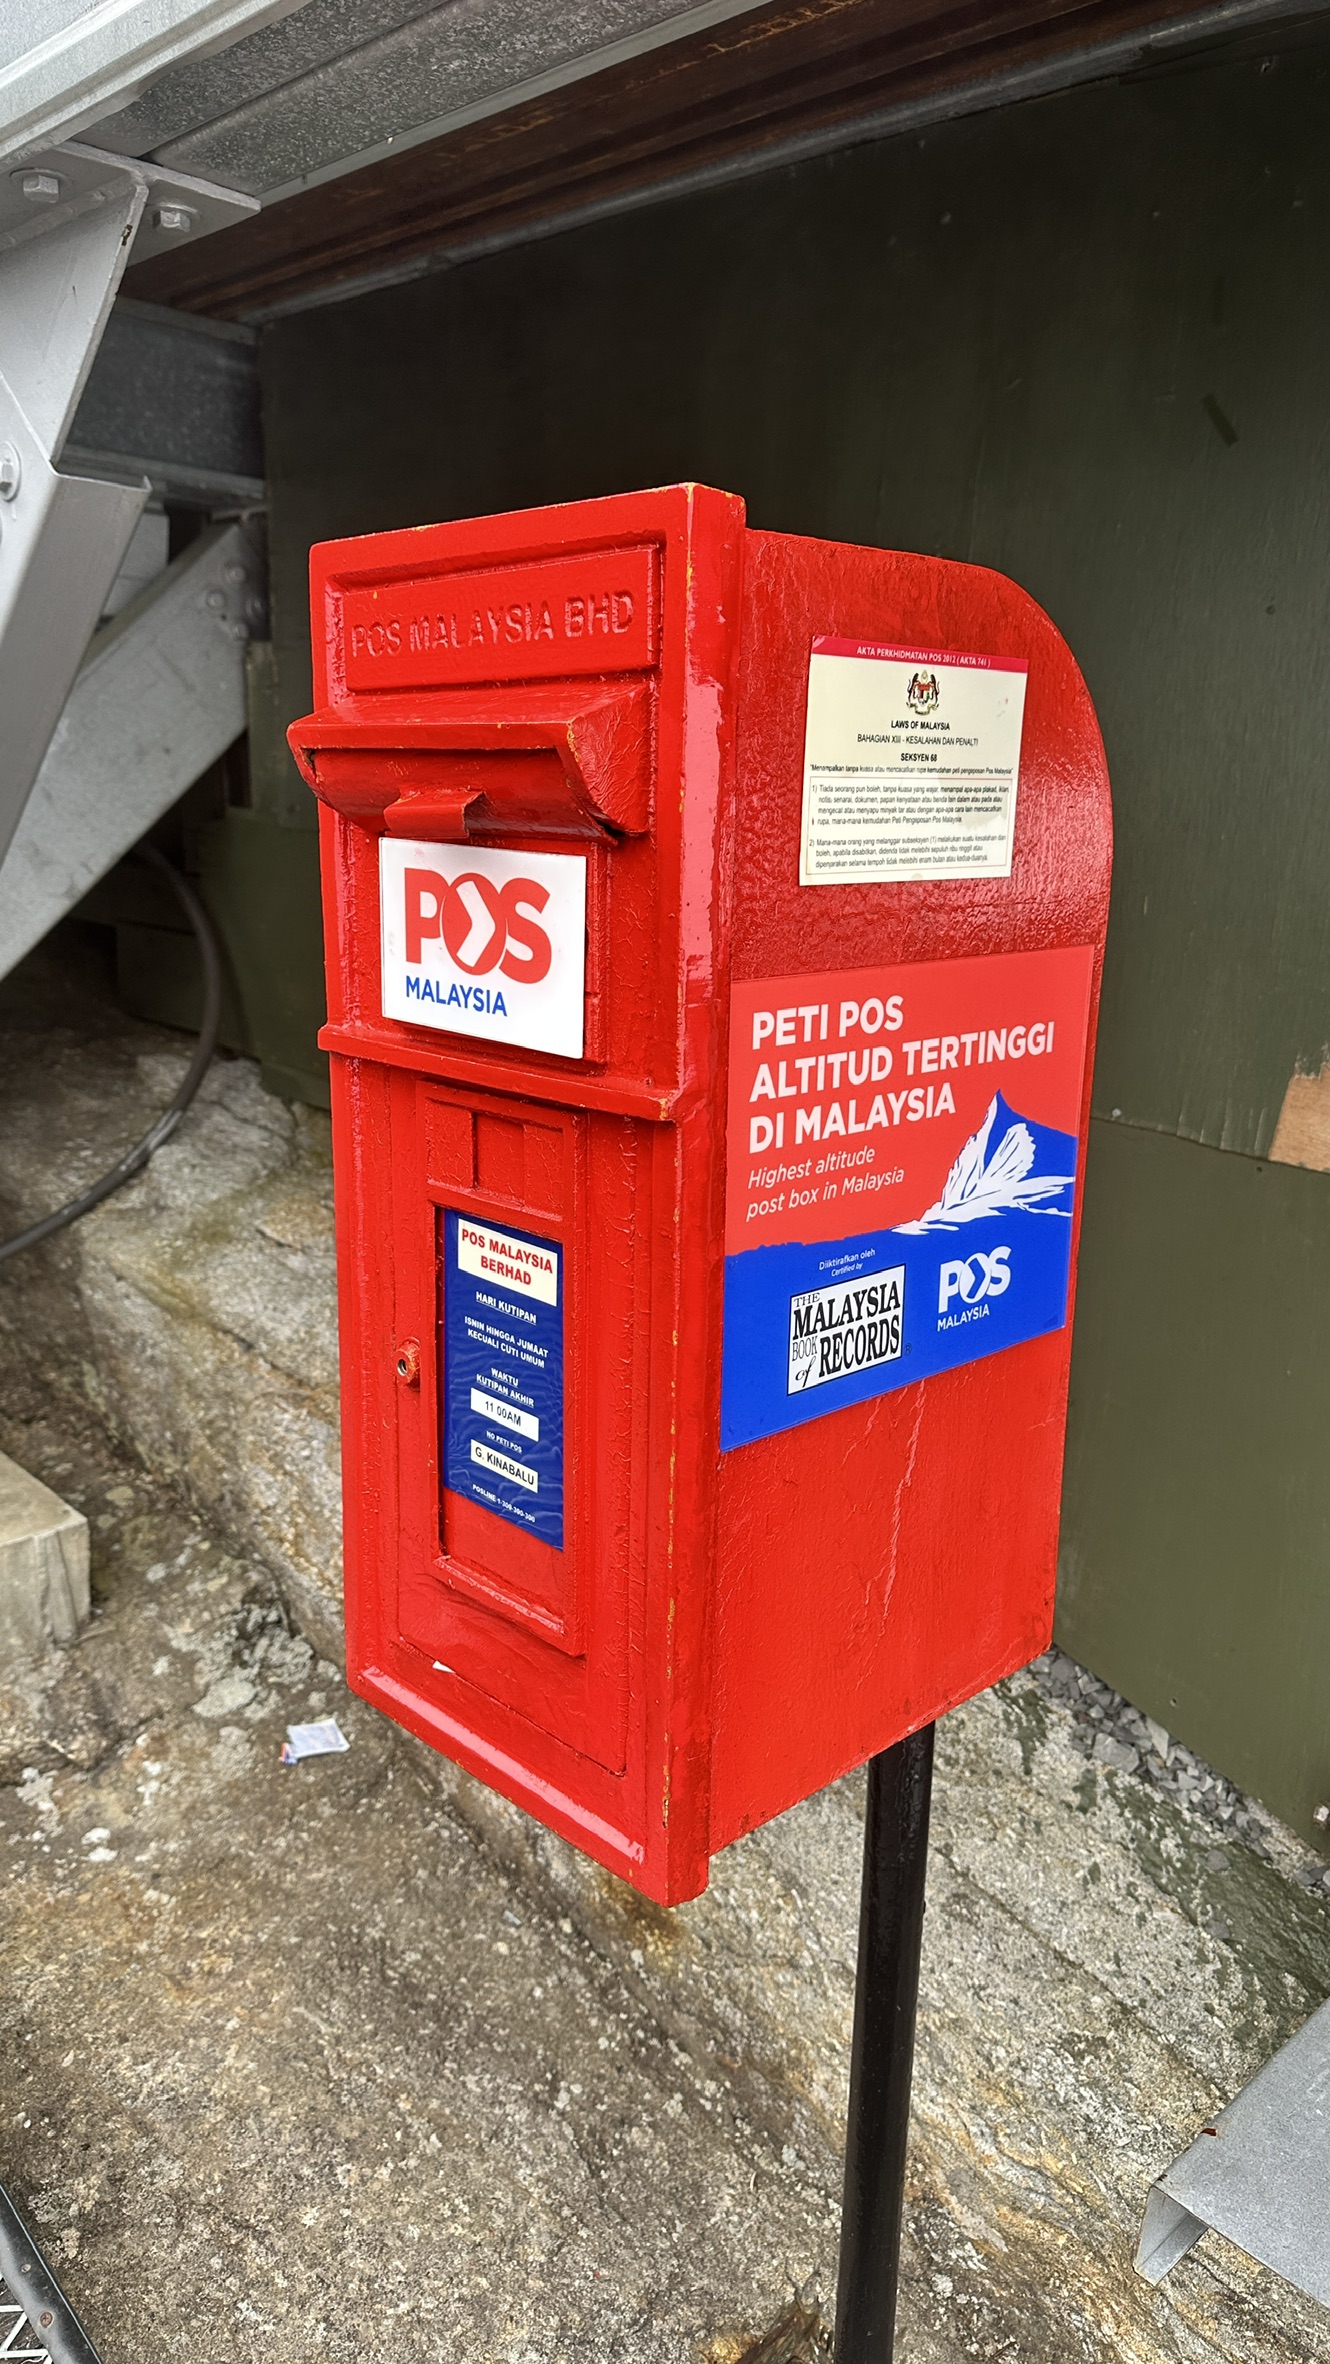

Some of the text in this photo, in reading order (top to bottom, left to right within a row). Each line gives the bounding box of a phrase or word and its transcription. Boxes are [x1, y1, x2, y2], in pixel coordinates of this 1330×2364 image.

[351, 589, 635, 657] POS MALAYSIA BHD
[857, 646, 876, 655] AKTA
[877, 648, 928, 660] PERKHIDMATAN
[929, 653, 941, 662] POS
[943, 655, 955, 663] 2012
[857, 734, 890, 743] BAHAGIAN
[892, 735, 901, 743] XIII
[906, 736, 941, 745] KESALAHAN
[942, 737, 954, 745] DAN
[956, 738, 978, 746] PENALTI
[891, 720, 950, 730] LAWS OF MALAYSIA
[900, 753, 937, 762] SEKSYEN 68
[404, 867, 552, 984] POS
[406, 975, 508, 1016] MALAYSIA
[752, 995, 904, 1050] PETI POS
[749, 1021, 1055, 1102] ALTITUD TERTINGGI
[749, 1082, 956, 1154] DI MALAYSIA
[747, 1145, 875, 1190] Highest altitude
[746, 1167, 905, 1222] post box in Malaysia
[462, 1228, 553, 1274] POS MALAYSIA
[819, 1248, 876, 1270] Diiktirafkan oleh
[481, 1255, 532, 1285] BERHAD
[831, 1262, 863, 1276] Certified by
[938, 1246, 1012, 1314] POS
[476, 1291, 536, 1324] HARI KUTIPAN
[792, 1281, 900, 1340] MALAYSIA
[793, 1292, 820, 1308] THE
[937, 1303, 990, 1332] MALAYSIA
[465, 1316, 548, 1358] ISNIN HINGGA JUMAAT
[468, 1328, 544, 1368] KECUALI CUTI UMUM
[792, 1336, 818, 1362] BOOK
[795, 1314, 900, 1388] of RECORDS
[477, 1374, 534, 1407] KUTIPAN AKHIR
[491, 1367, 518, 1387] WAKTU
[486, 1430, 522, 1454] NO PETI POS
[475, 1447, 534, 1485] G. KINABALU
[473, 1484, 496, 1502] POSLINE
